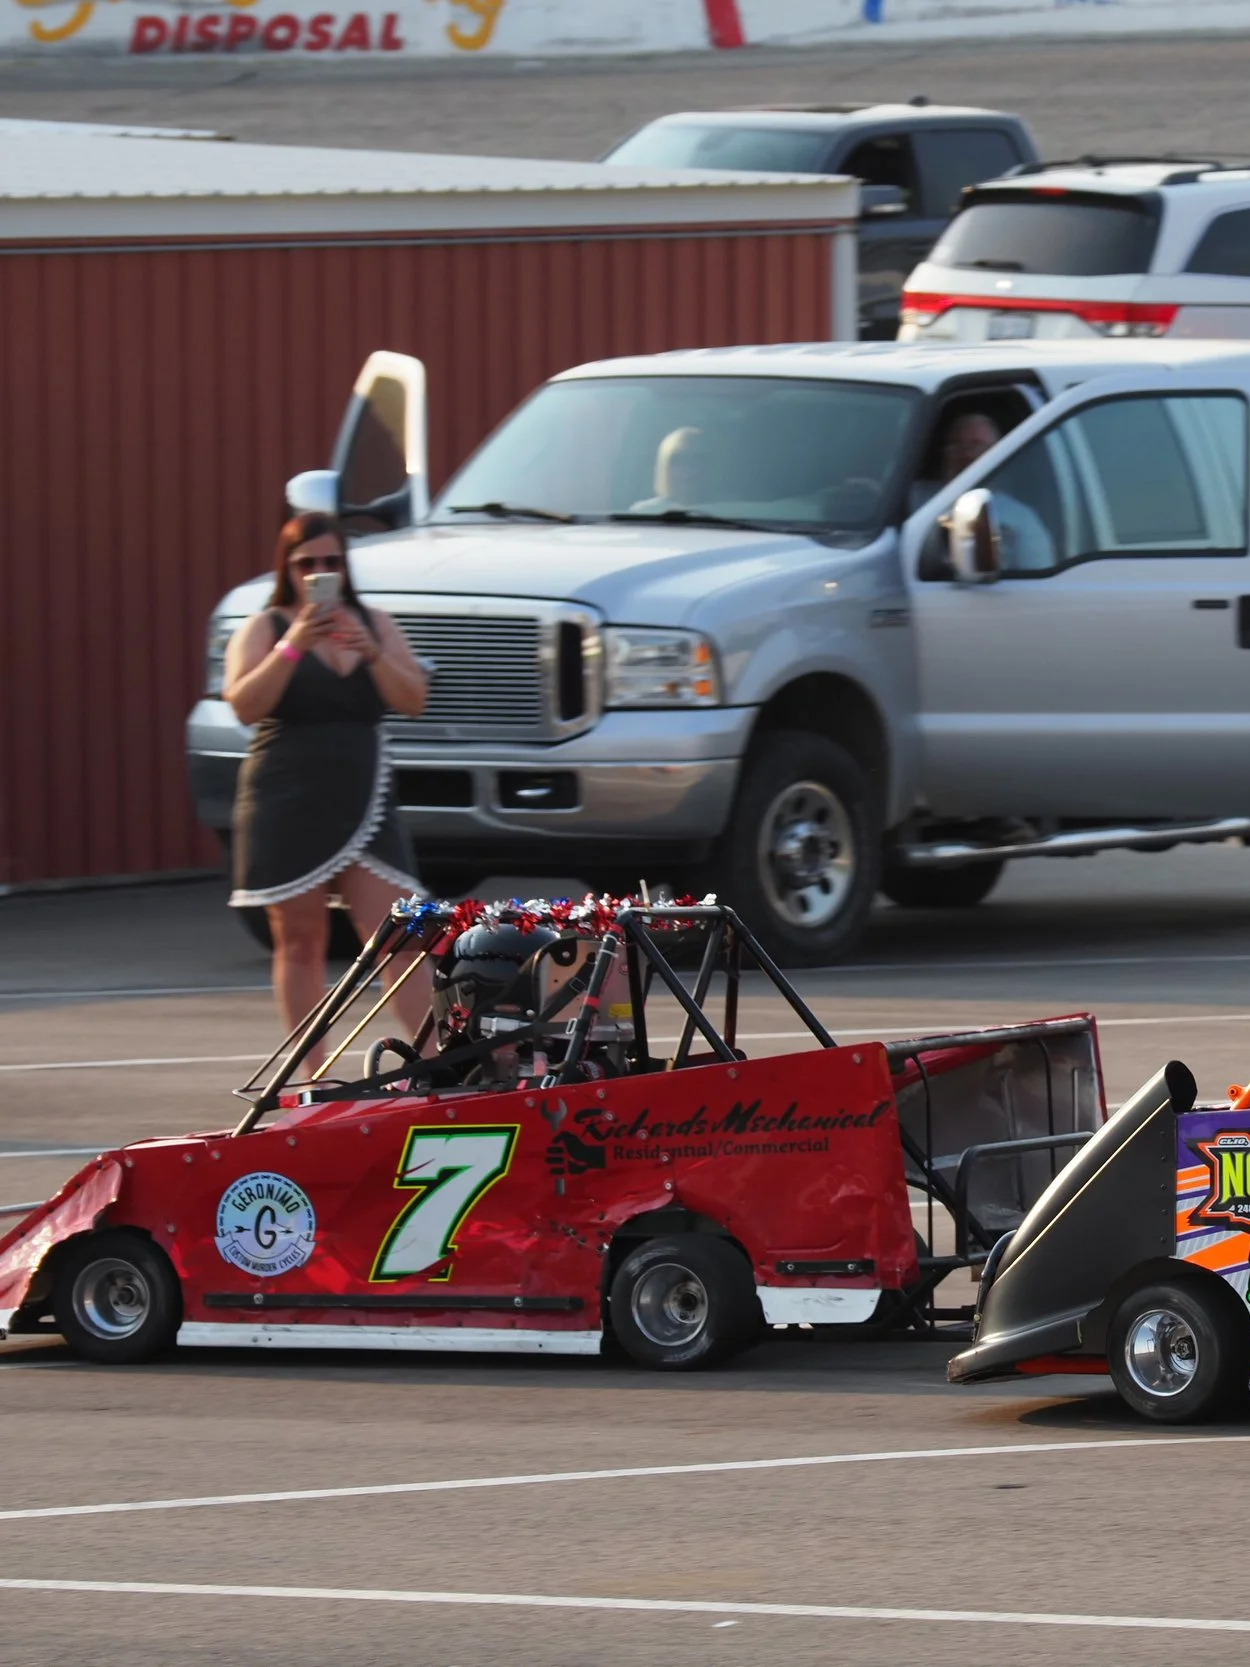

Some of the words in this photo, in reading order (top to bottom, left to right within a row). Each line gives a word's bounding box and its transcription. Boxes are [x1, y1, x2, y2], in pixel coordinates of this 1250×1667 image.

[130, 13, 404, 54] DISPOSAL
[711, 1100, 891, 1134] Mechanical
[231, 1183, 300, 1213] GERONIMO
[368, 1123, 522, 1283] 7
[254, 1205, 277, 1249] G
